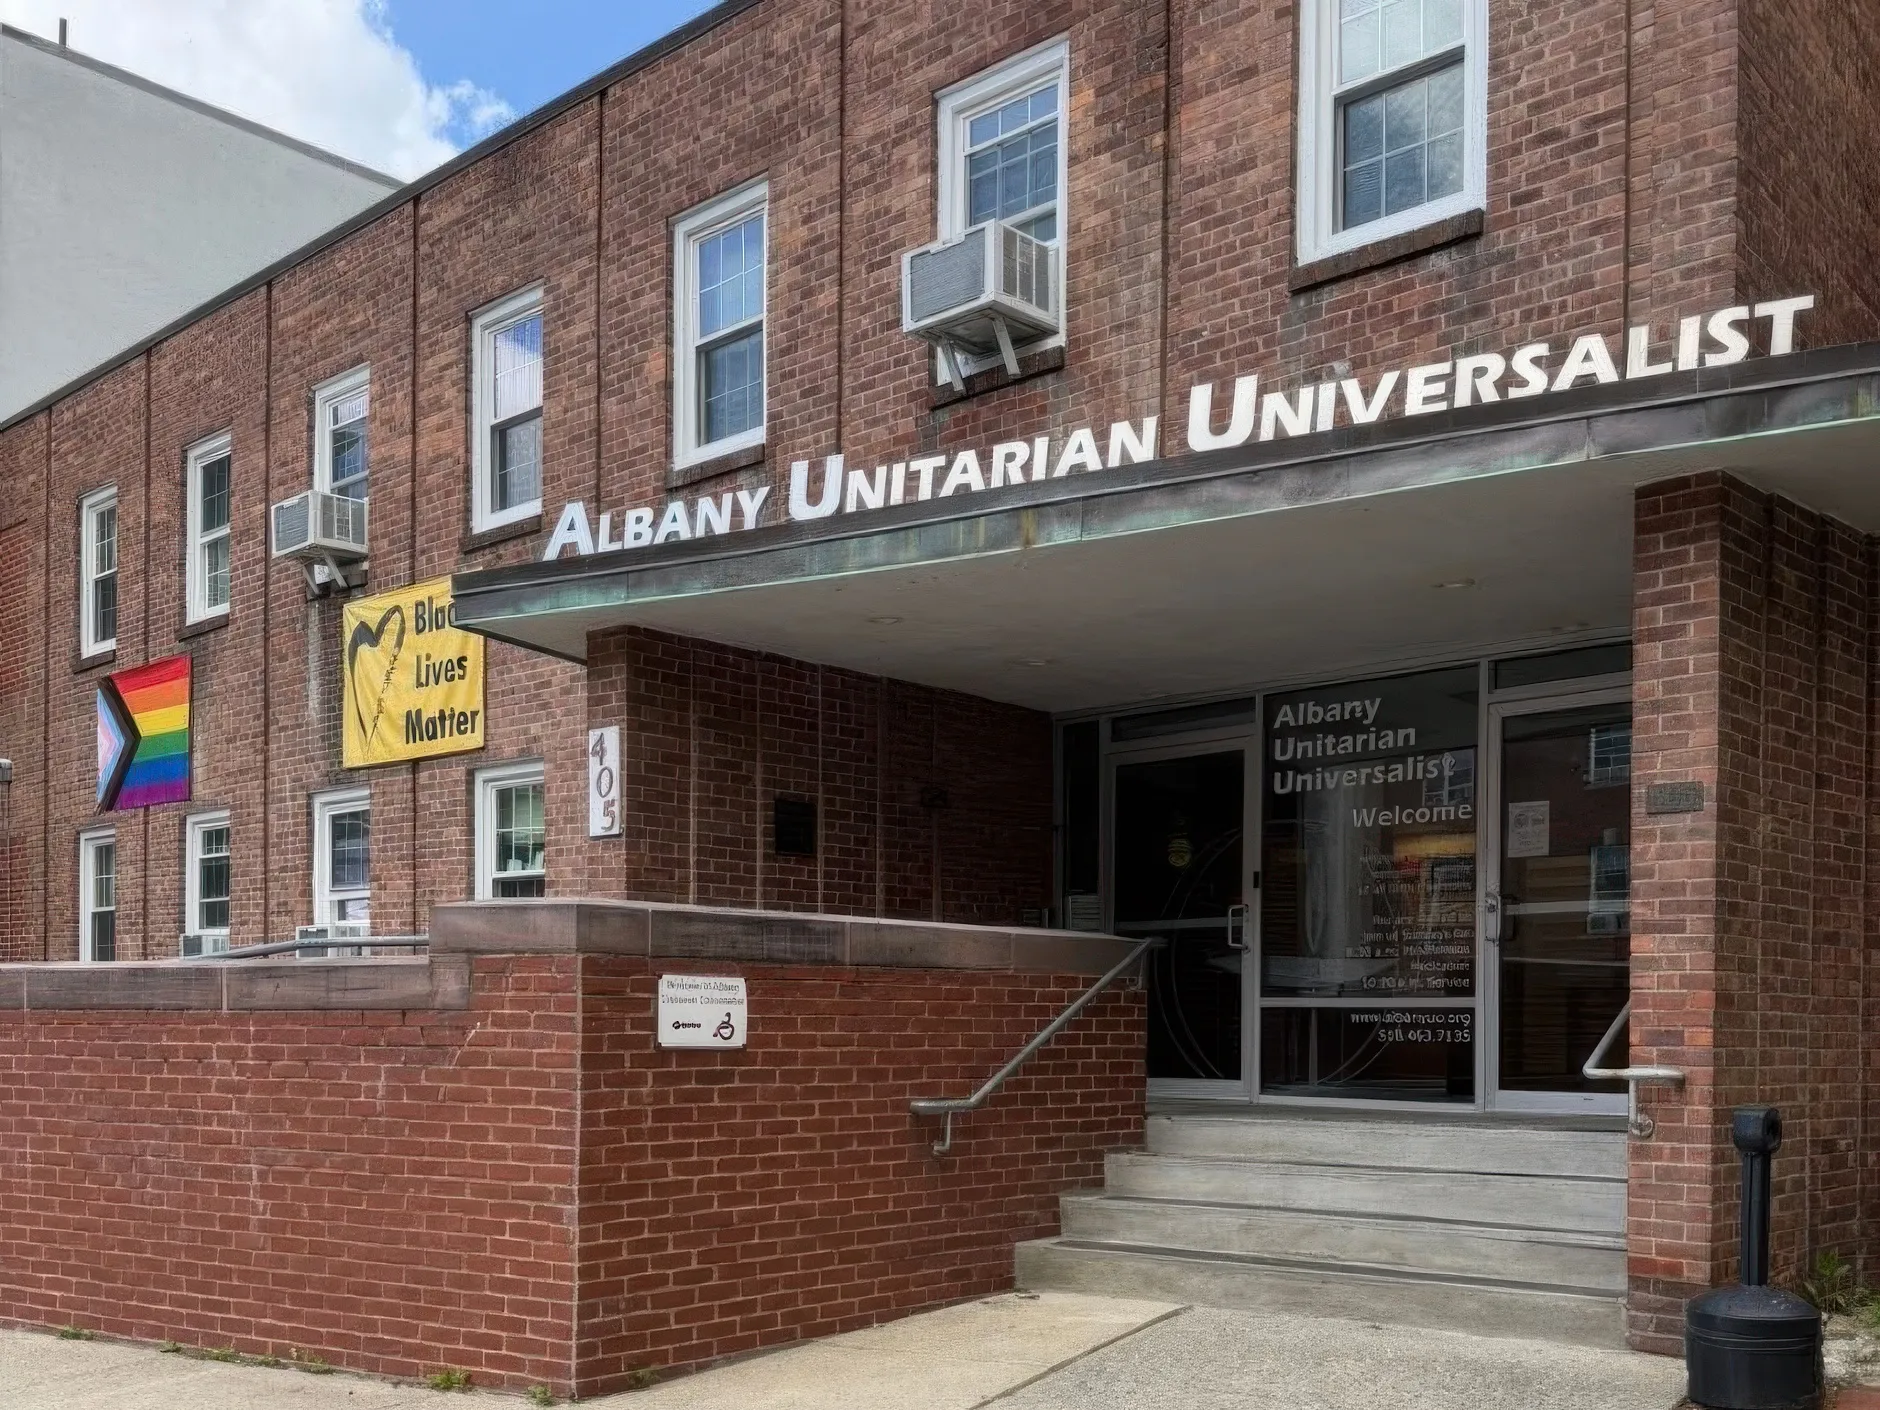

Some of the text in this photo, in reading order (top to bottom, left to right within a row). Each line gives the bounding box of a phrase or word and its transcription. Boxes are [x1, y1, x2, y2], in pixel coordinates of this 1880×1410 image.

[542, 295, 1815, 562] ALBANY UNITARIAN UNIVERSALIST
[414, 596, 456, 636] Blac
[415, 652, 468, 689] Lives
[404, 706, 480, 745] Matter
[1273, 697, 1382, 729] Albany
[1273, 727, 1416, 761] Unitarian
[590, 732, 617, 833] 405
[1272, 752, 1456, 795] Universalist
[1352, 802, 1473, 828] Welcome
